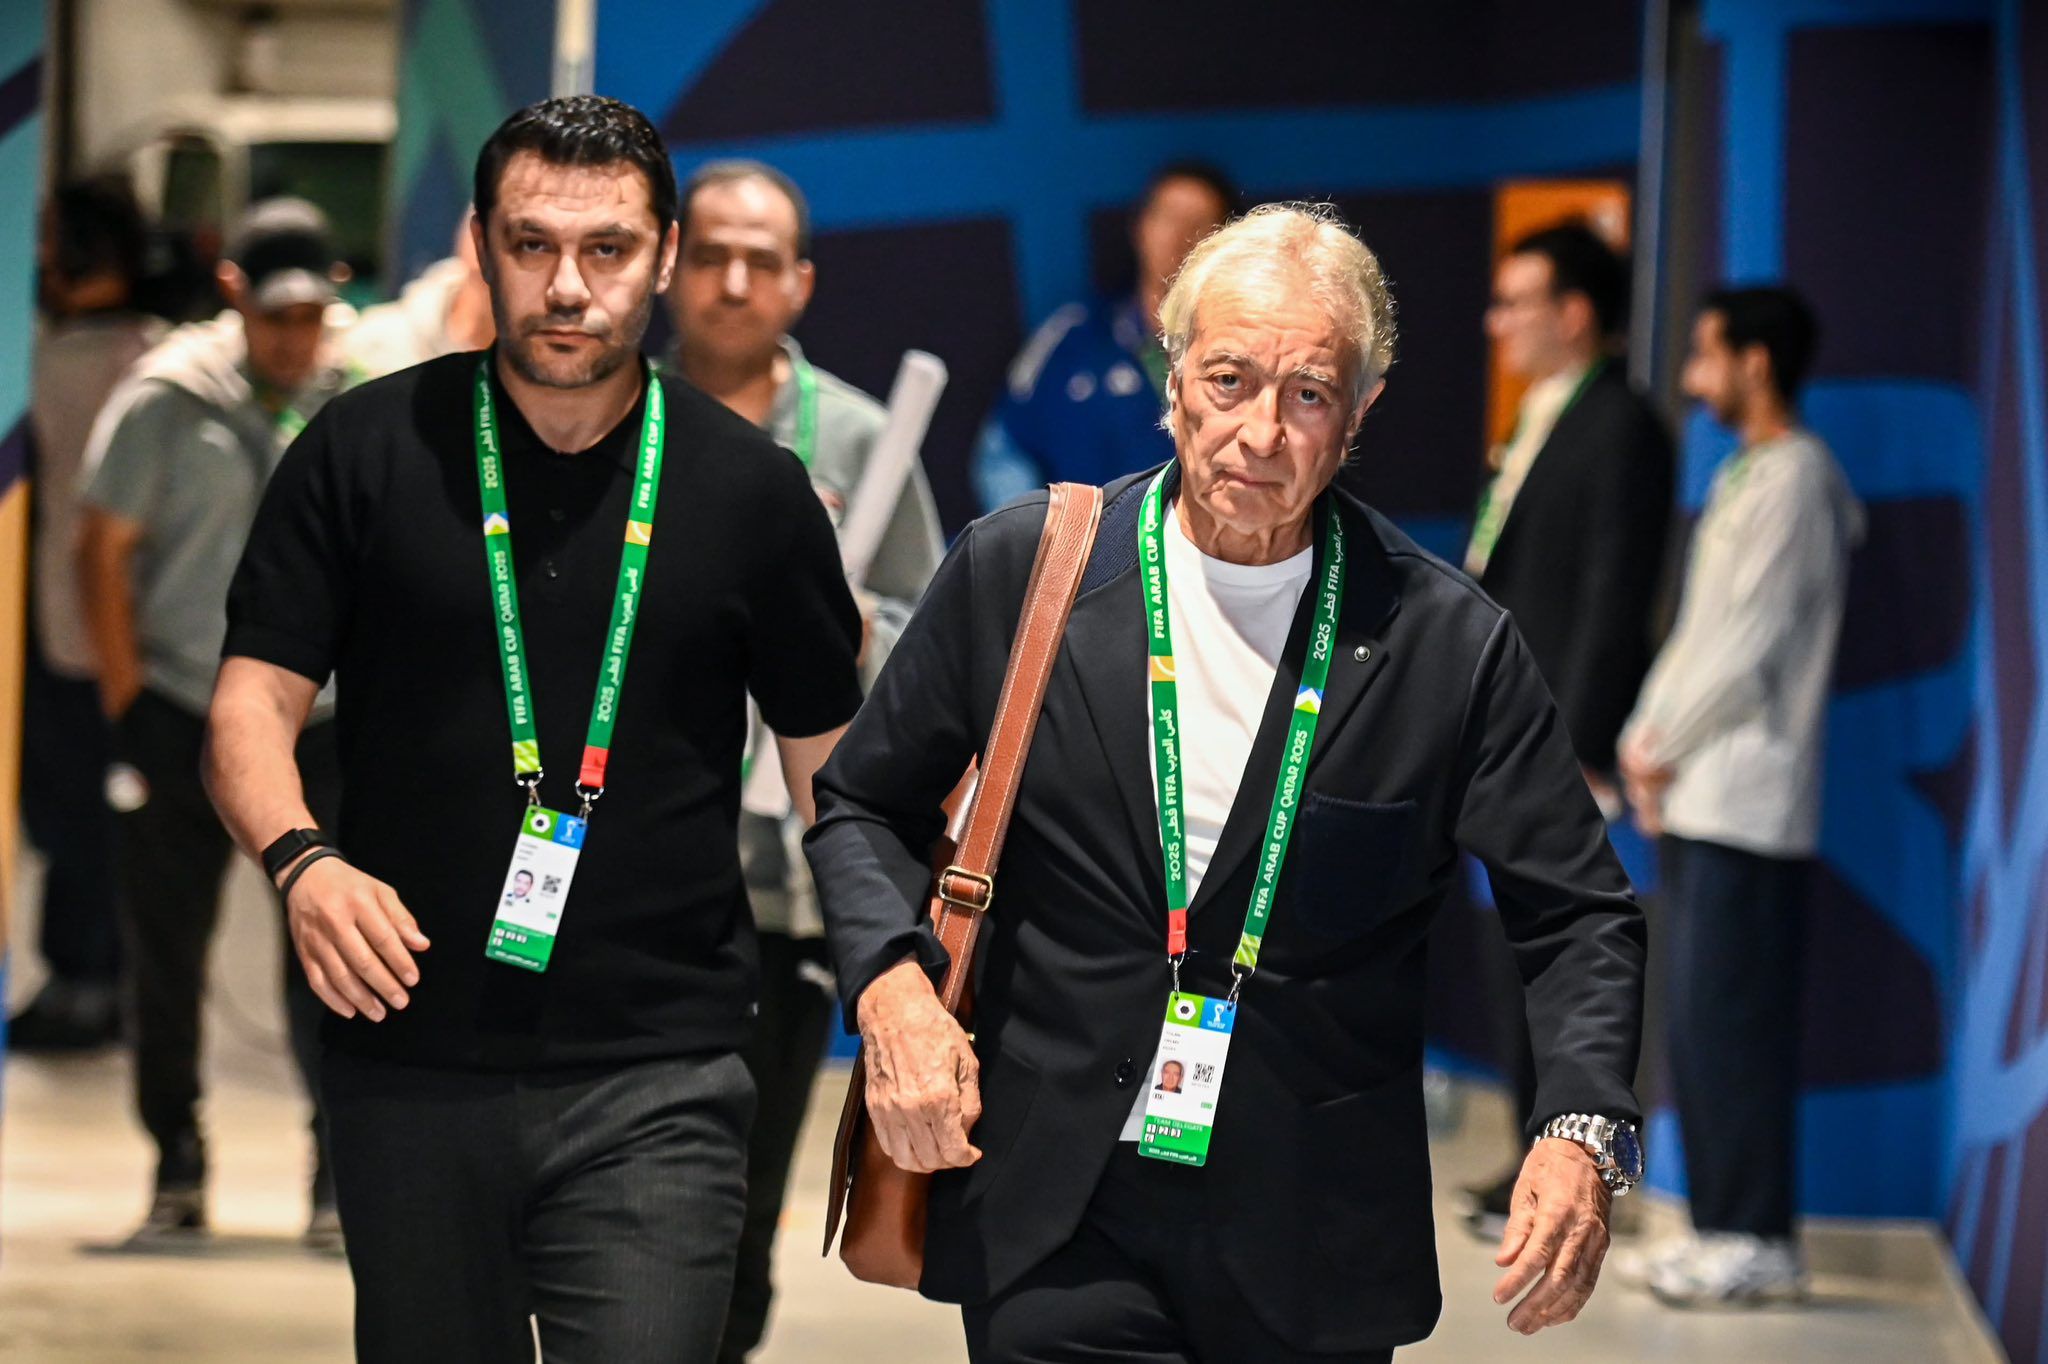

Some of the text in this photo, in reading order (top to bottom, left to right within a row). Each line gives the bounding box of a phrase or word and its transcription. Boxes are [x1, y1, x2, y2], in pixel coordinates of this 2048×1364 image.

[647, 421, 659, 445] CUP
[643, 446, 657, 479] ARAB
[638, 483, 652, 509] FIFA
[1145, 535, 1159, 563] CUP
[1333, 534, 1344, 563] العرب
[1148, 565, 1163, 605] ARAB
[1327, 565, 1340, 591] FIFA
[1153, 608, 1165, 639] FIFA
[1323, 592, 1337, 624] قطر
[503, 625, 518, 653] CUP
[611, 626, 628, 654] FIFA
[1312, 623, 1331, 661] 2025
[507, 654, 523, 692] ARAB
[513, 695, 528, 725] FIFA
[597, 686, 615, 723] 2025
[1159, 709, 1182, 882] كأس العرب FIFA قطر 2025
[1253, 729, 1308, 918] FIFA ARAB CUP QATAR 2025
